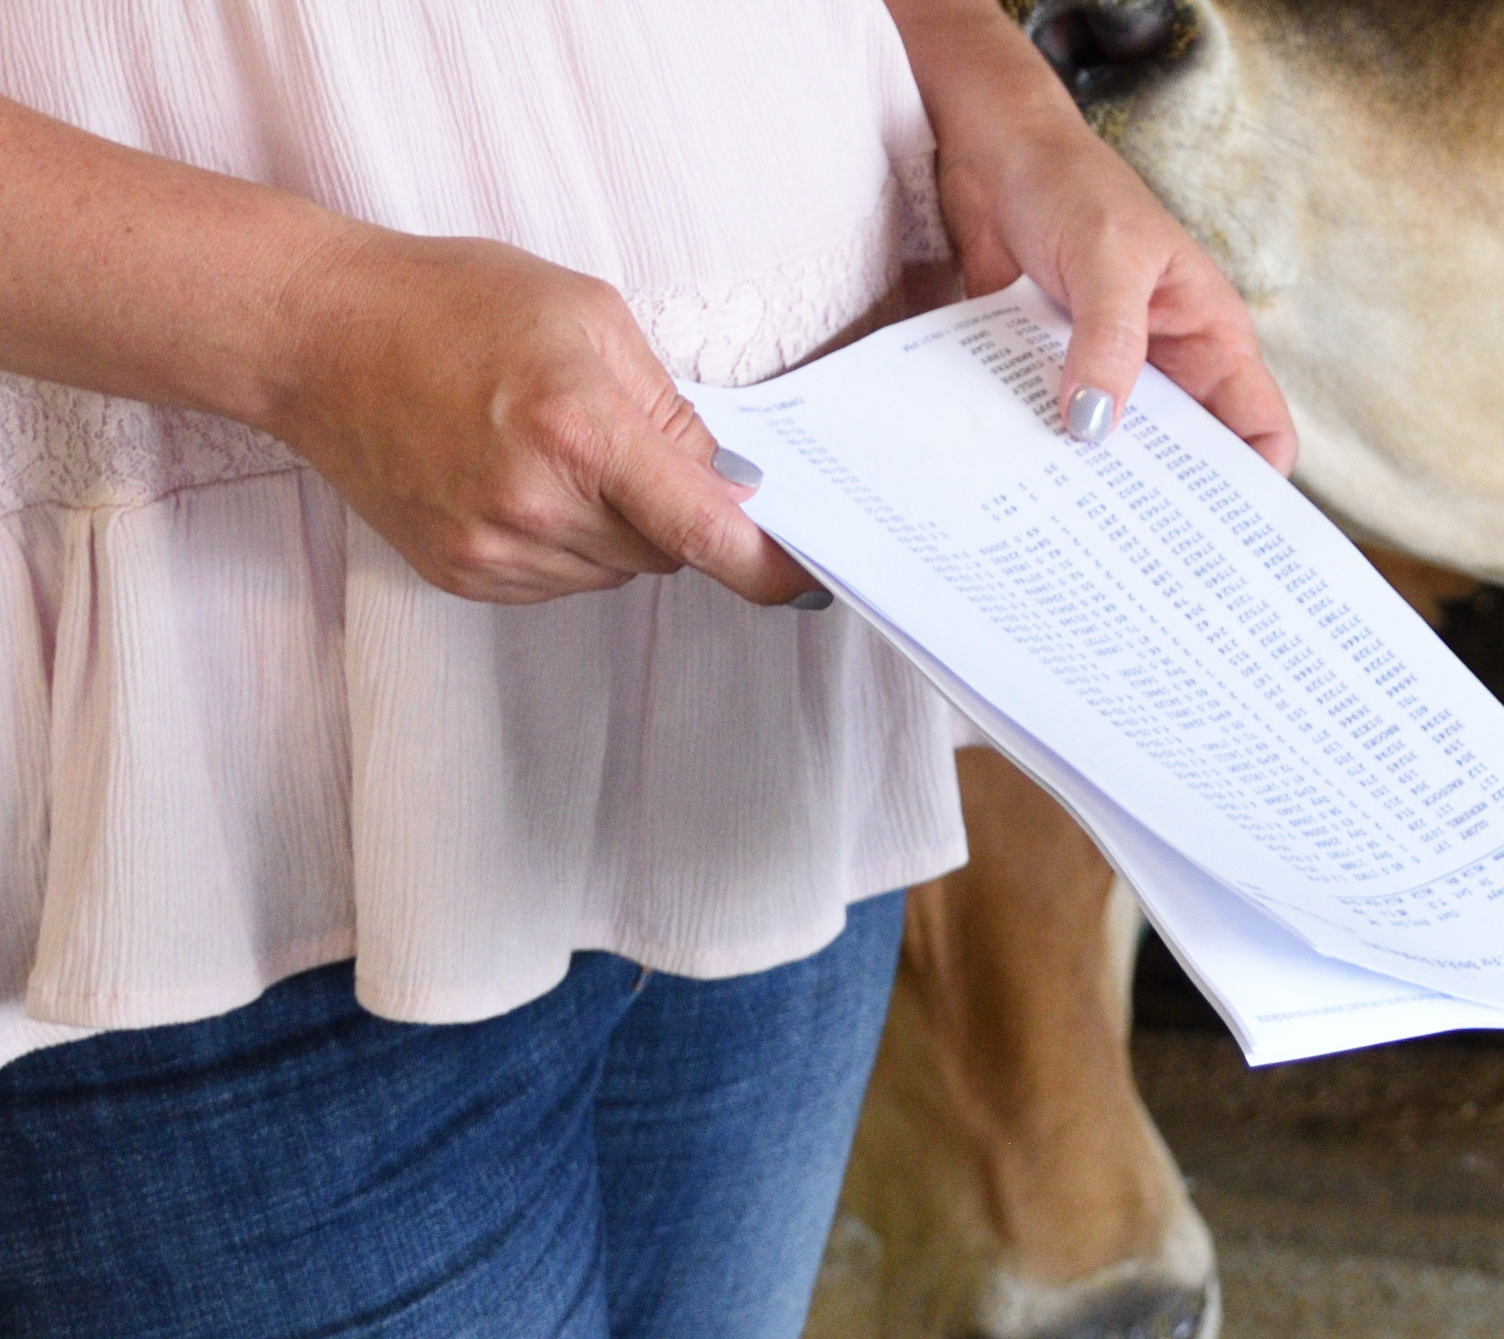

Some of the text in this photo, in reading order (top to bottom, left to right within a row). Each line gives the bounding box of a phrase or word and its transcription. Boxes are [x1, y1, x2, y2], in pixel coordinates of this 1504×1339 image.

[1043, 464, 1058, 475] 35
[1054, 474, 1069, 486] 33
[1177, 459, 1209, 481] 37668
[1187, 469, 1219, 492] 37663
[1129, 487, 1161, 510] 37668
[1198, 480, 1231, 502] 37653
[1087, 503, 1107, 519] 432
[1139, 498, 1172, 522] 37663
[1150, 509, 1182, 533] 37653
[1099, 513, 1118, 531] 287
[1109, 525, 1129, 542] 282
[1129, 490, 1241, 564] 37629 37629 273
[1231, 512, 1263, 535] 37612
[1119, 536, 1139, 552] 260
[1140, 501, 1252, 576] 37623 37623 288
[1252, 534, 1285, 557] 37540
[1162, 523, 1274, 598] 37598 37598 195
[1183, 542, 1215, 567] 37612
[1151, 570, 1173, 587] 188
[1184, 545, 1296, 621] 37524 37524 304
[1204, 565, 1237, 588] 37540
[1196, 562, 1302, 632] 7204 7204 42
[1296, 579, 1329, 605] 37518
[1173, 599, 1189, 609] 79
[1206, 568, 1317, 644] 37522 37522 266
[1228, 597, 1334, 666] 7202 7202 515
[1248, 611, 1280, 636] 37518
[1217, 638, 1239, 655] 234
[1240, 603, 1351, 677] 37383 37383 260
[1253, 614, 1362, 689] 37357 37357 167
[1263, 626, 1373, 699] 37446 37446 290
[1275, 638, 1384, 710] 37328 37328 30
[1374, 661, 1407, 686] 36999
[1286, 650, 1395, 722] 37224 37224 103
[1313, 673, 1418, 744] 36946 36946 277
[1327, 693, 1360, 716] 36999
[1397, 695, 1418, 709] 701
[1420, 708, 1452, 733] 35294
[1431, 720, 1464, 744] 35245
[1334, 705, 1429, 766] 601 BROOKS 205
[1322, 741, 1342, 755] 139
[1374, 739, 1406, 762] 35294
[1455, 750, 1476, 767] 304
[1370, 738, 1464, 798] 159 159 153
[1386, 751, 1417, 773] 35245
[1467, 762, 1488, 779] 112
[1358, 773, 1378, 788] 274
[1410, 781, 1430, 796] 304
[1383, 796, 1403, 810] 210
[1407, 773, 1499, 832] 117 117 228
[1420, 826, 1441, 843] 1030
[1435, 840, 1447, 854] 197
